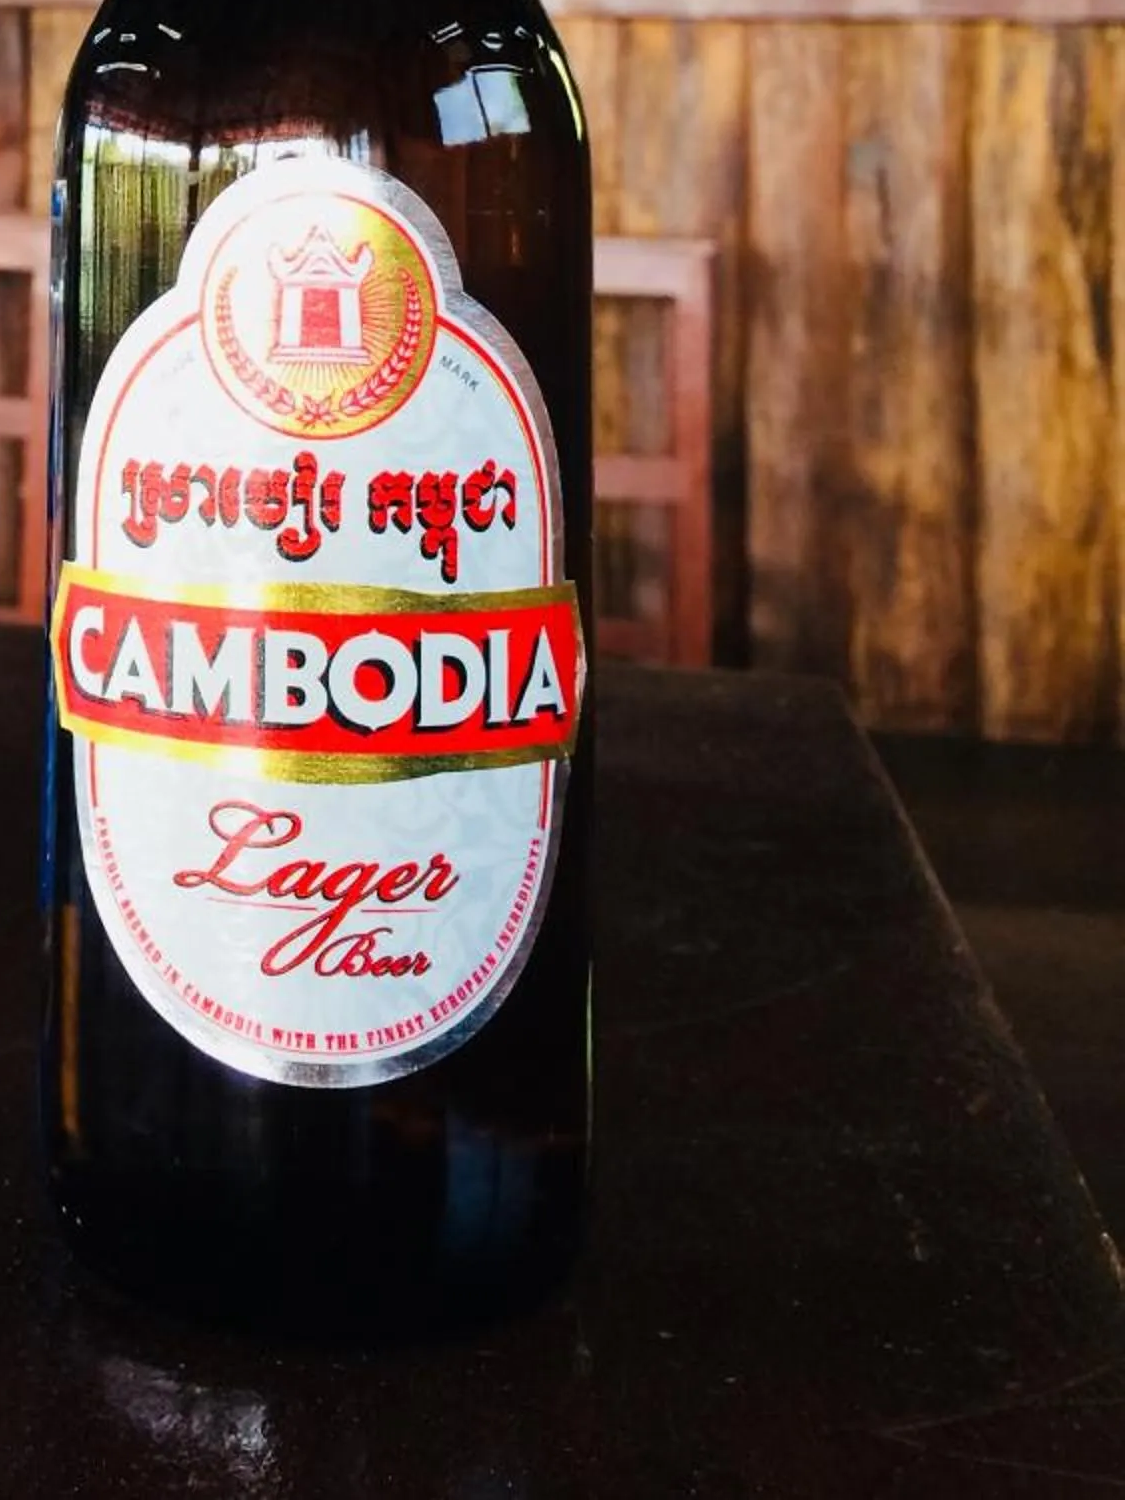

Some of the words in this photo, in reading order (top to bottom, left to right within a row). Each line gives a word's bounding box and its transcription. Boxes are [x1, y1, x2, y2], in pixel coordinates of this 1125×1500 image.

[438, 355, 479, 392] MARK
[69, 605, 567, 734] CAMBODIA
[173, 798, 460, 978] Lager
[184, 984, 262, 1039] CAMBODIA
[272, 1027, 317, 1050] WITH
[325, 1031, 359, 1050] THE
[366, 1015, 425, 1047] FINEST
[429, 952, 499, 1023] EUROPEAN
[495, 838, 541, 951] INGREDIENTS
[315, 927, 432, 978] Beer
